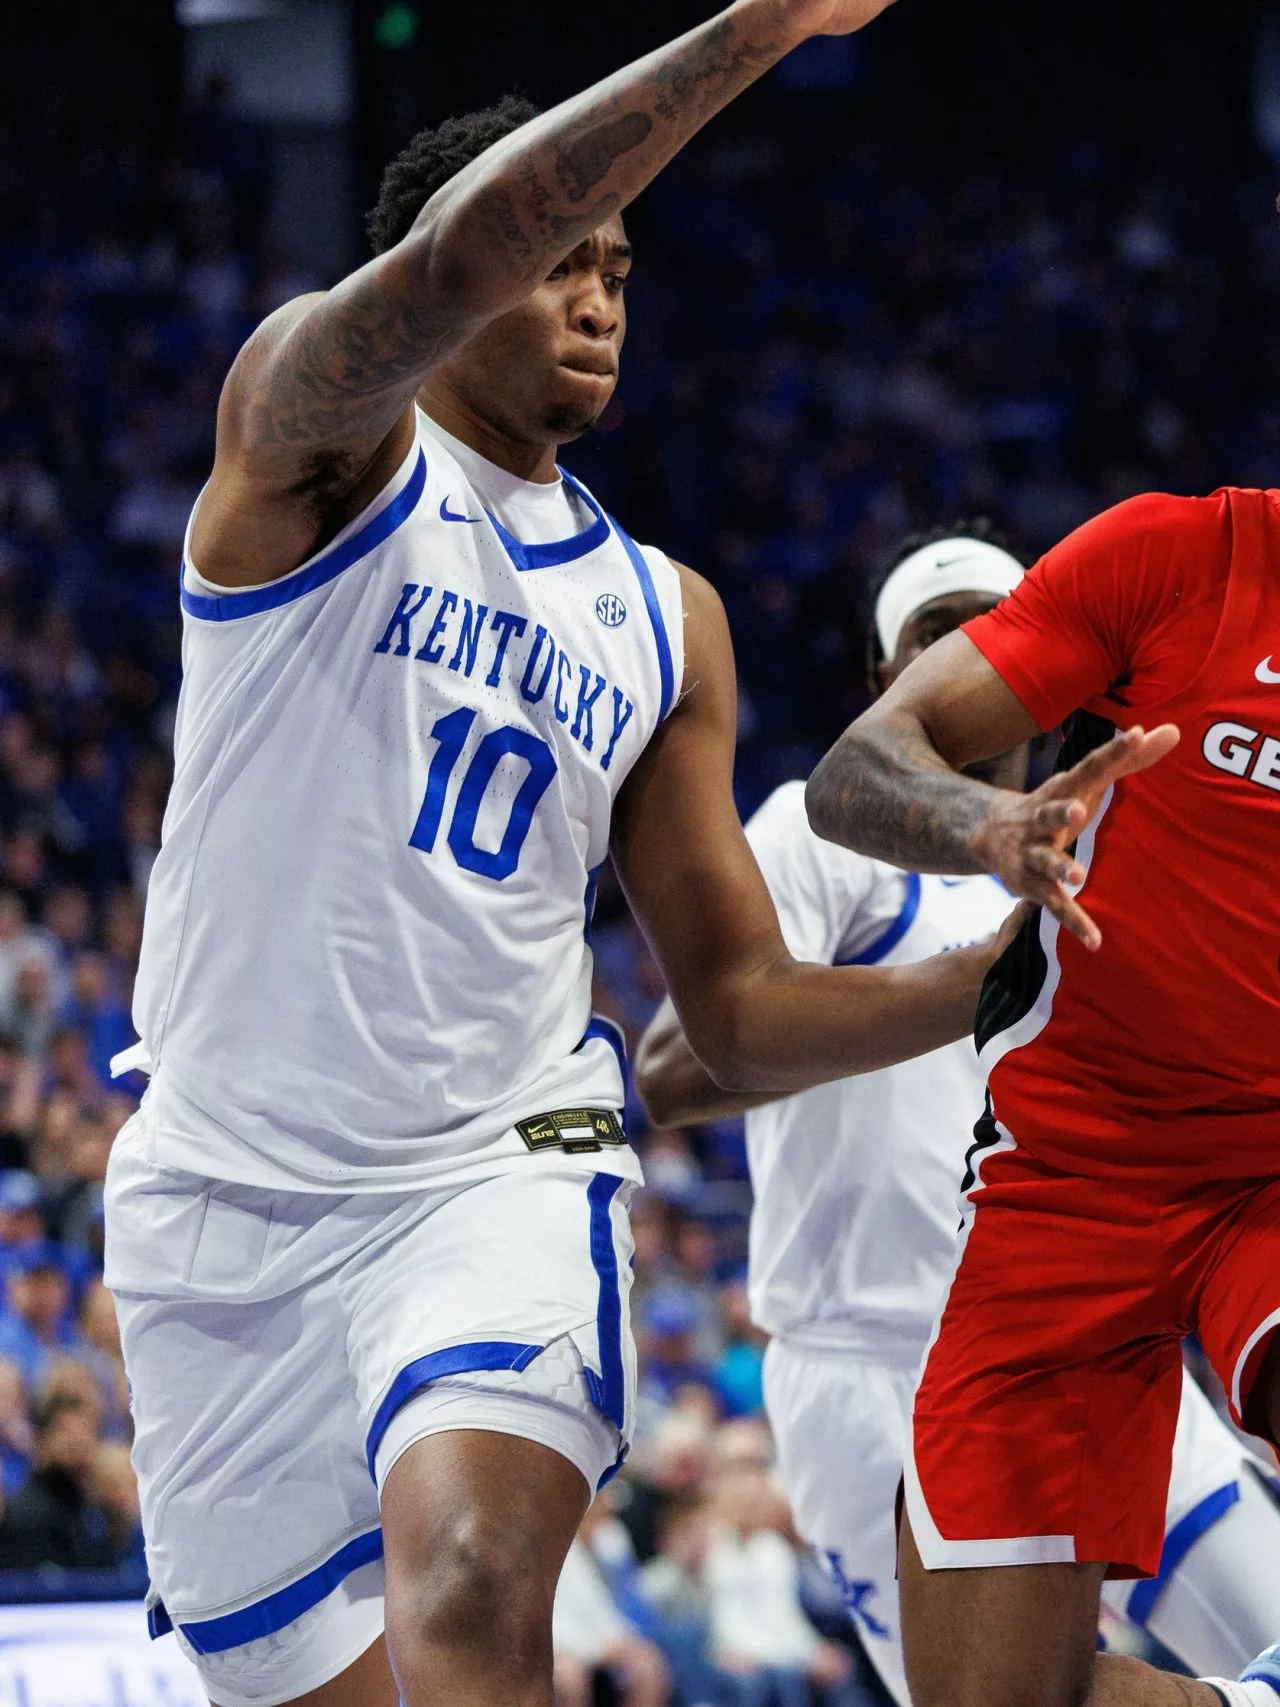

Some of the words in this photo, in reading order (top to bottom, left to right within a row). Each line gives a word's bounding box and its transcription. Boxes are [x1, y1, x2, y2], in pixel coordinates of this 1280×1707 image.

[373, 583, 634, 772] KENTUCKY
[597, 595, 627, 627] SEC
[407, 706, 559, 882] 10
